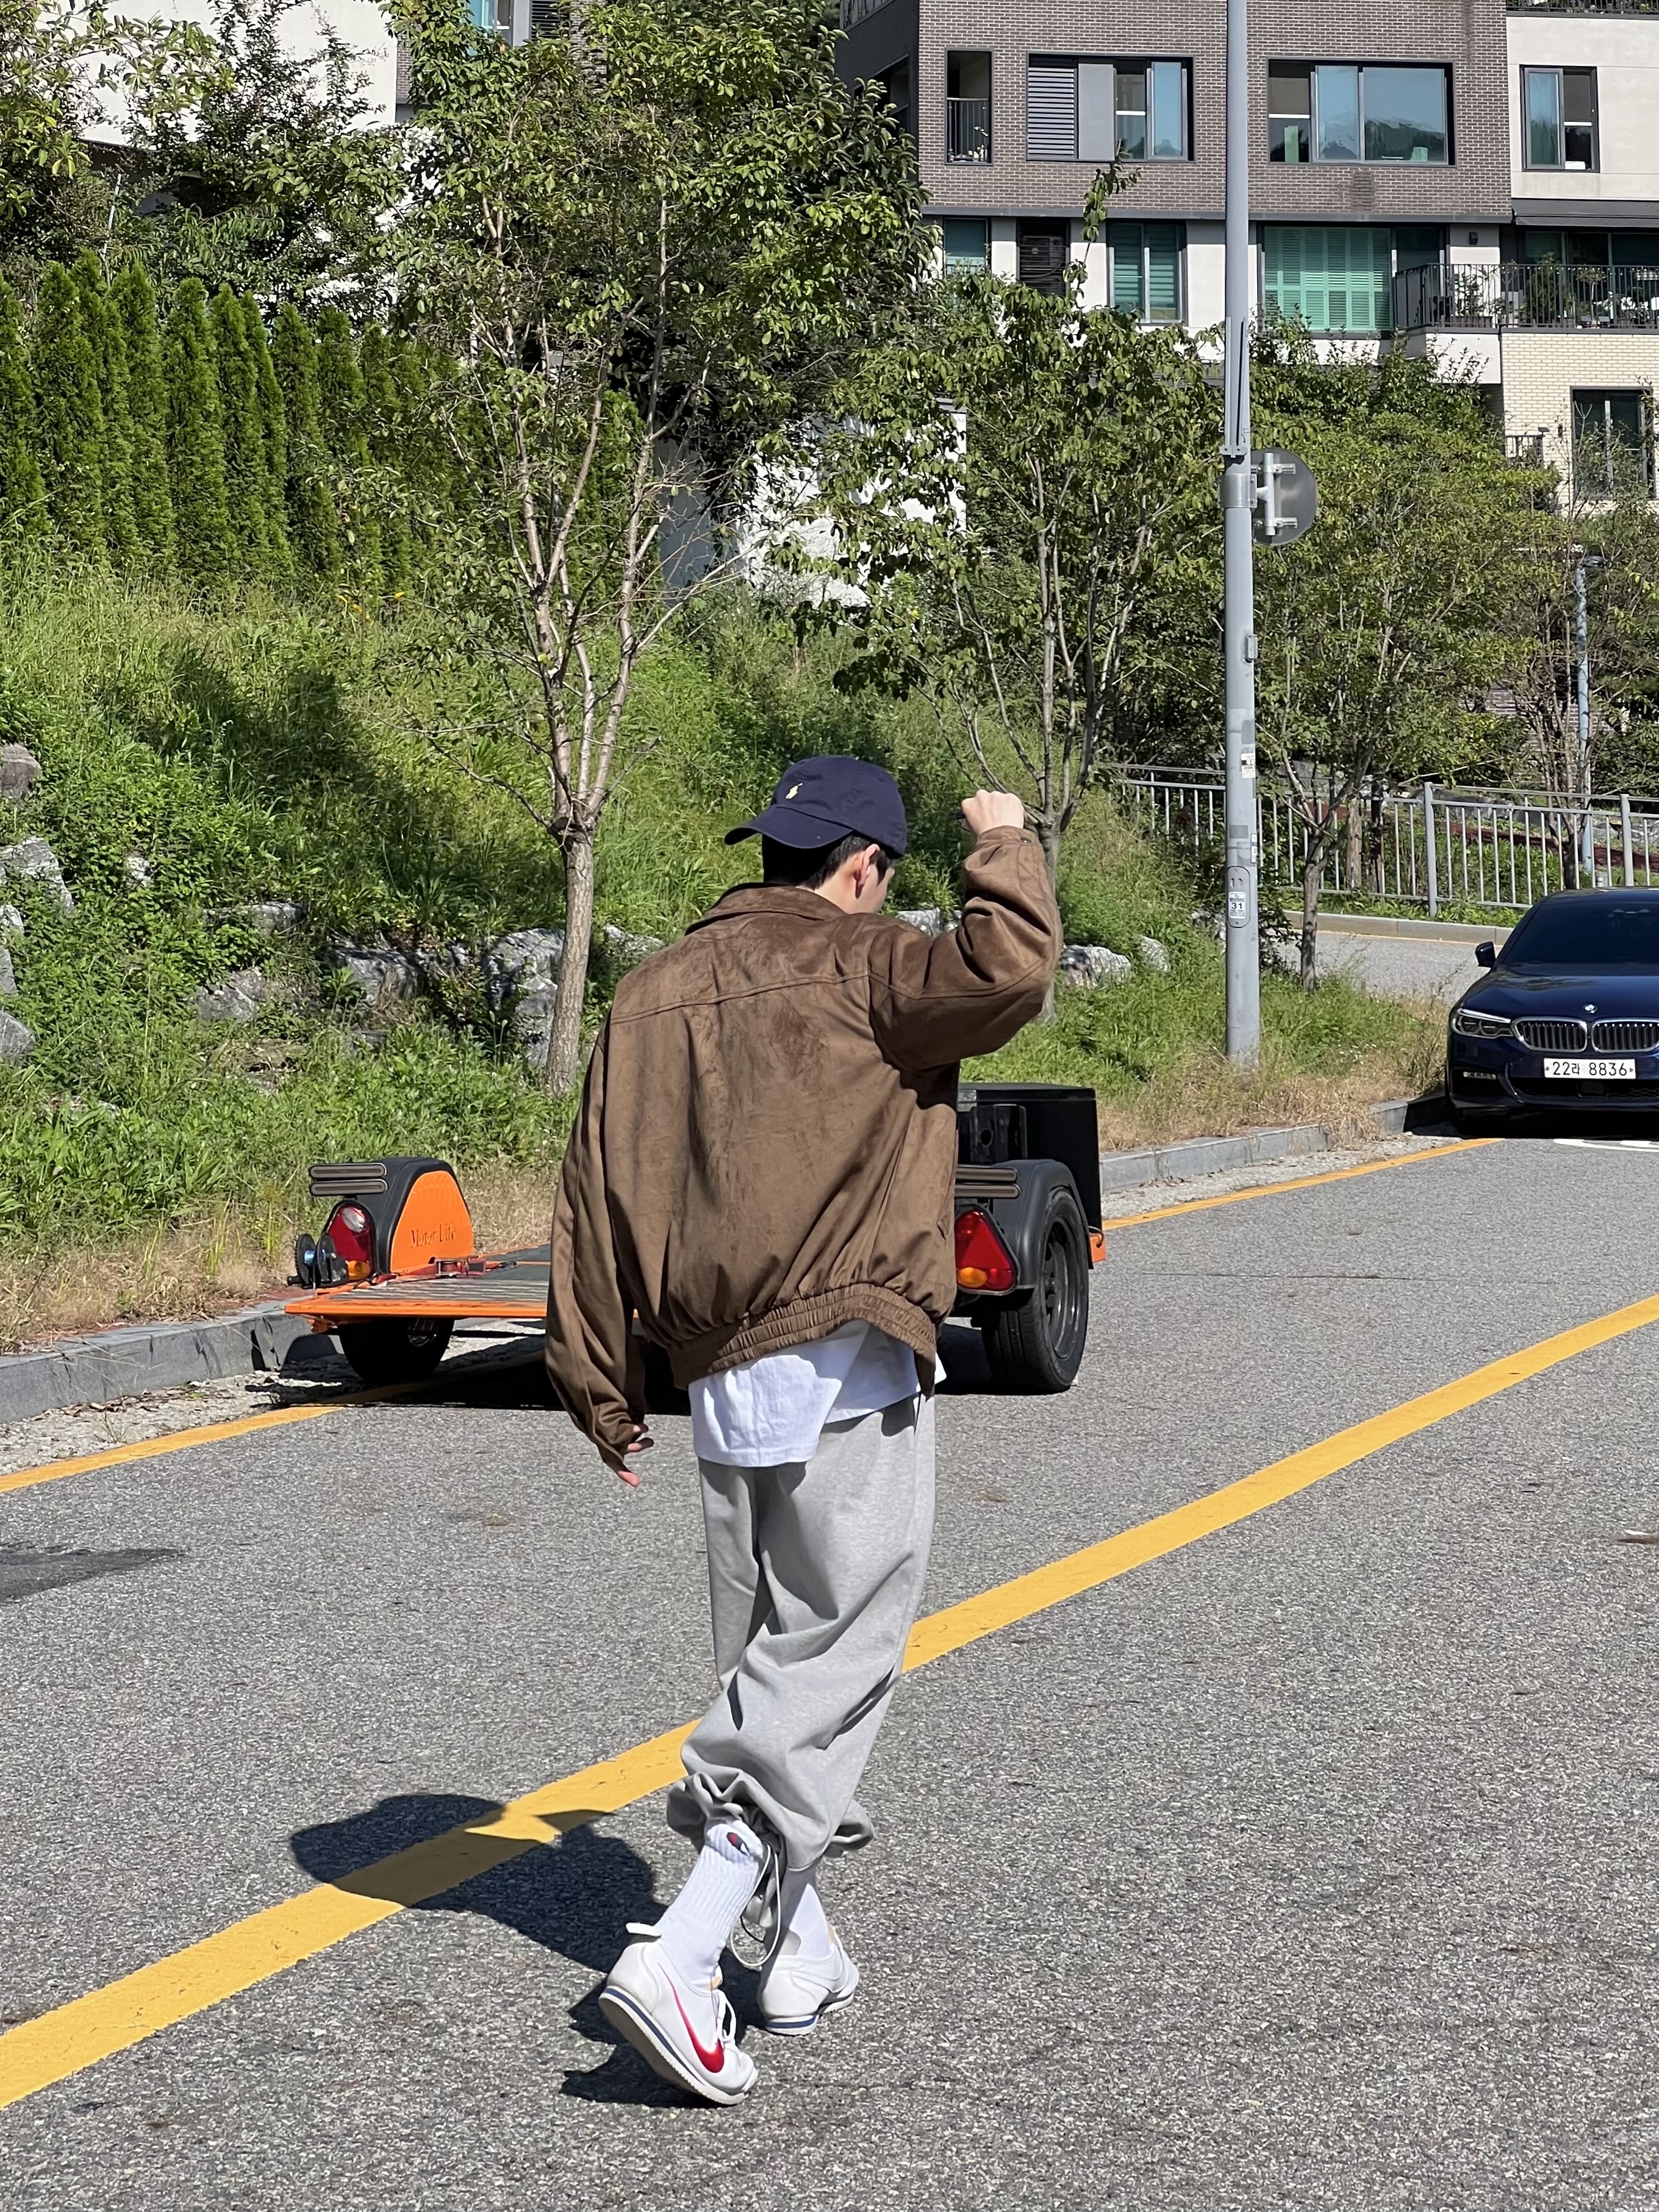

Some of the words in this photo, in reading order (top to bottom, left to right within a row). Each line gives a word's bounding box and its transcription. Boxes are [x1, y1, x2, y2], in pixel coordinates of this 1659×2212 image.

[1552, 1061, 1580, 1075] 22라
[1589, 1062, 1627, 1076] 8836
[411, 1229, 437, 1248] Motor
